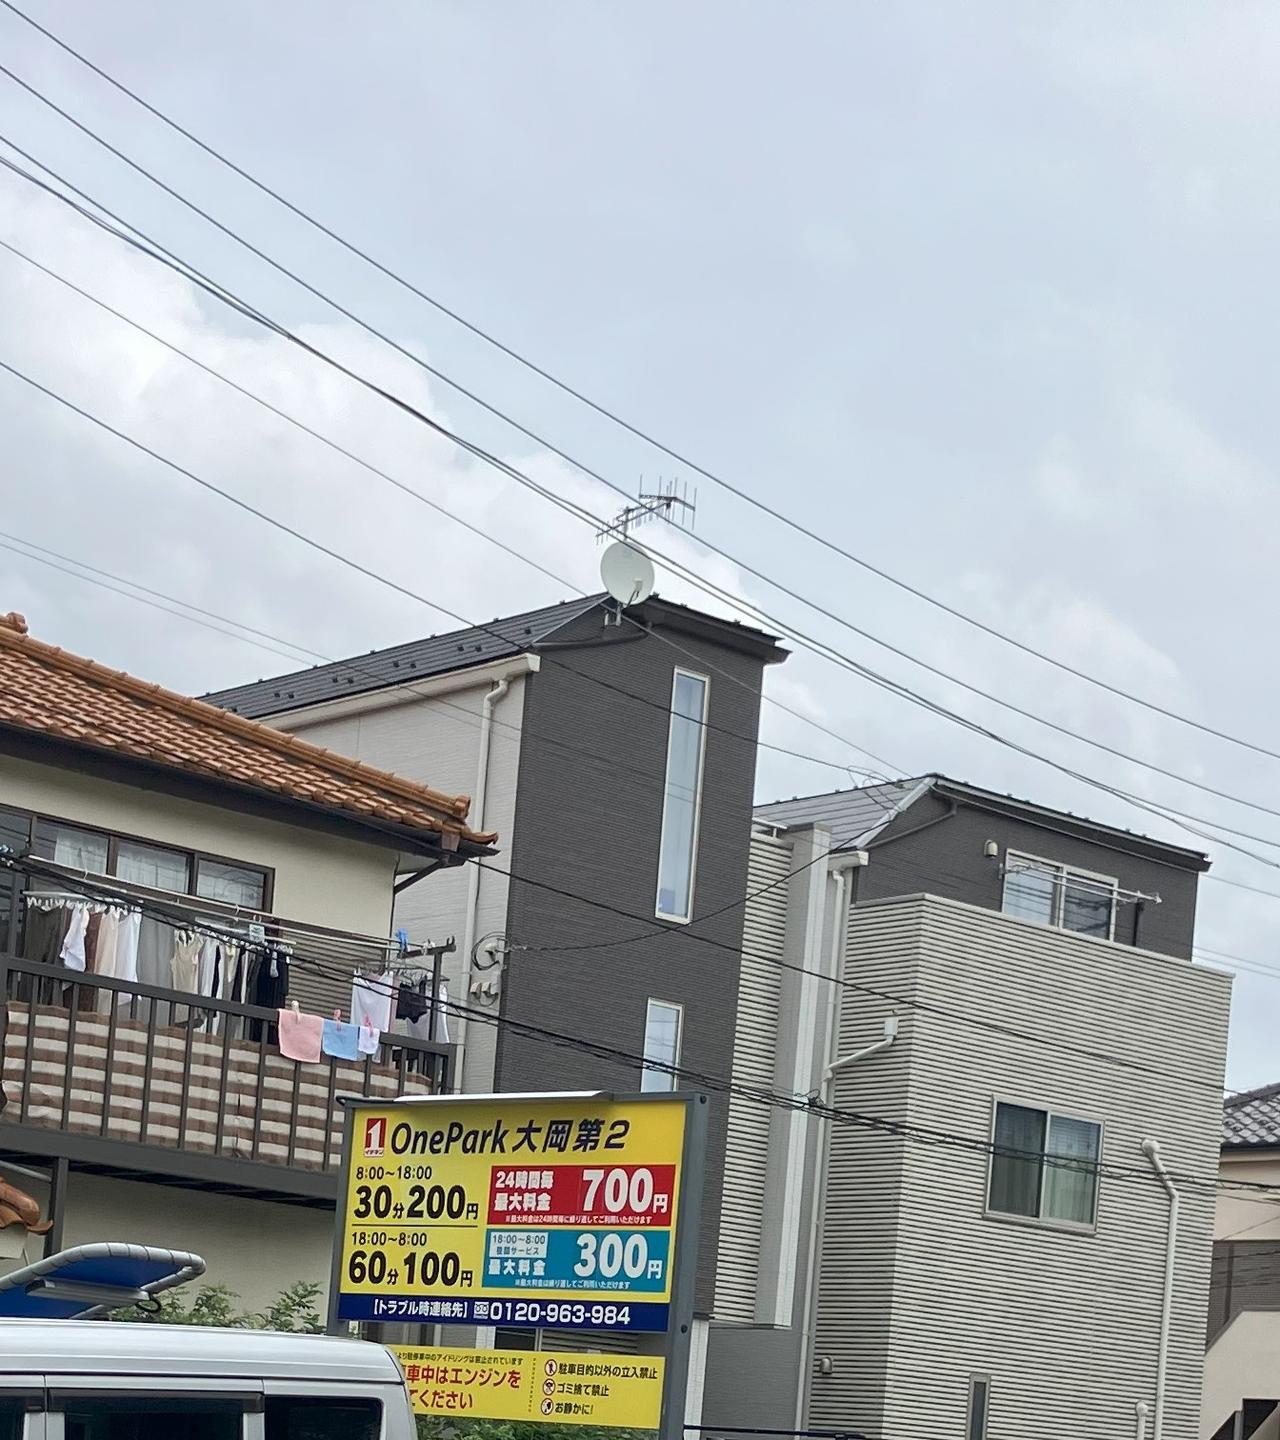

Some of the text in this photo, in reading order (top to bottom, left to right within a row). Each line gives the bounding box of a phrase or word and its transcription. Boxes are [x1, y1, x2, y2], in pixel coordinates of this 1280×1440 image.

[582, 1168, 669, 1214] 700円
[494, 1192, 551, 1212] 最大料金
[574, 1233, 663, 1280] 300円
[489, 1259, 546, 1276] 最大料金
[490, 1302, 631, 1325] 0120-963-984
[403, 1364, 521, 1388] 車中はエンジンを
[558, 1363, 657, 1379] 駐車目的以外の立入禁止
[557, 1383, 609, 1396] ゴミ捨て禁止
